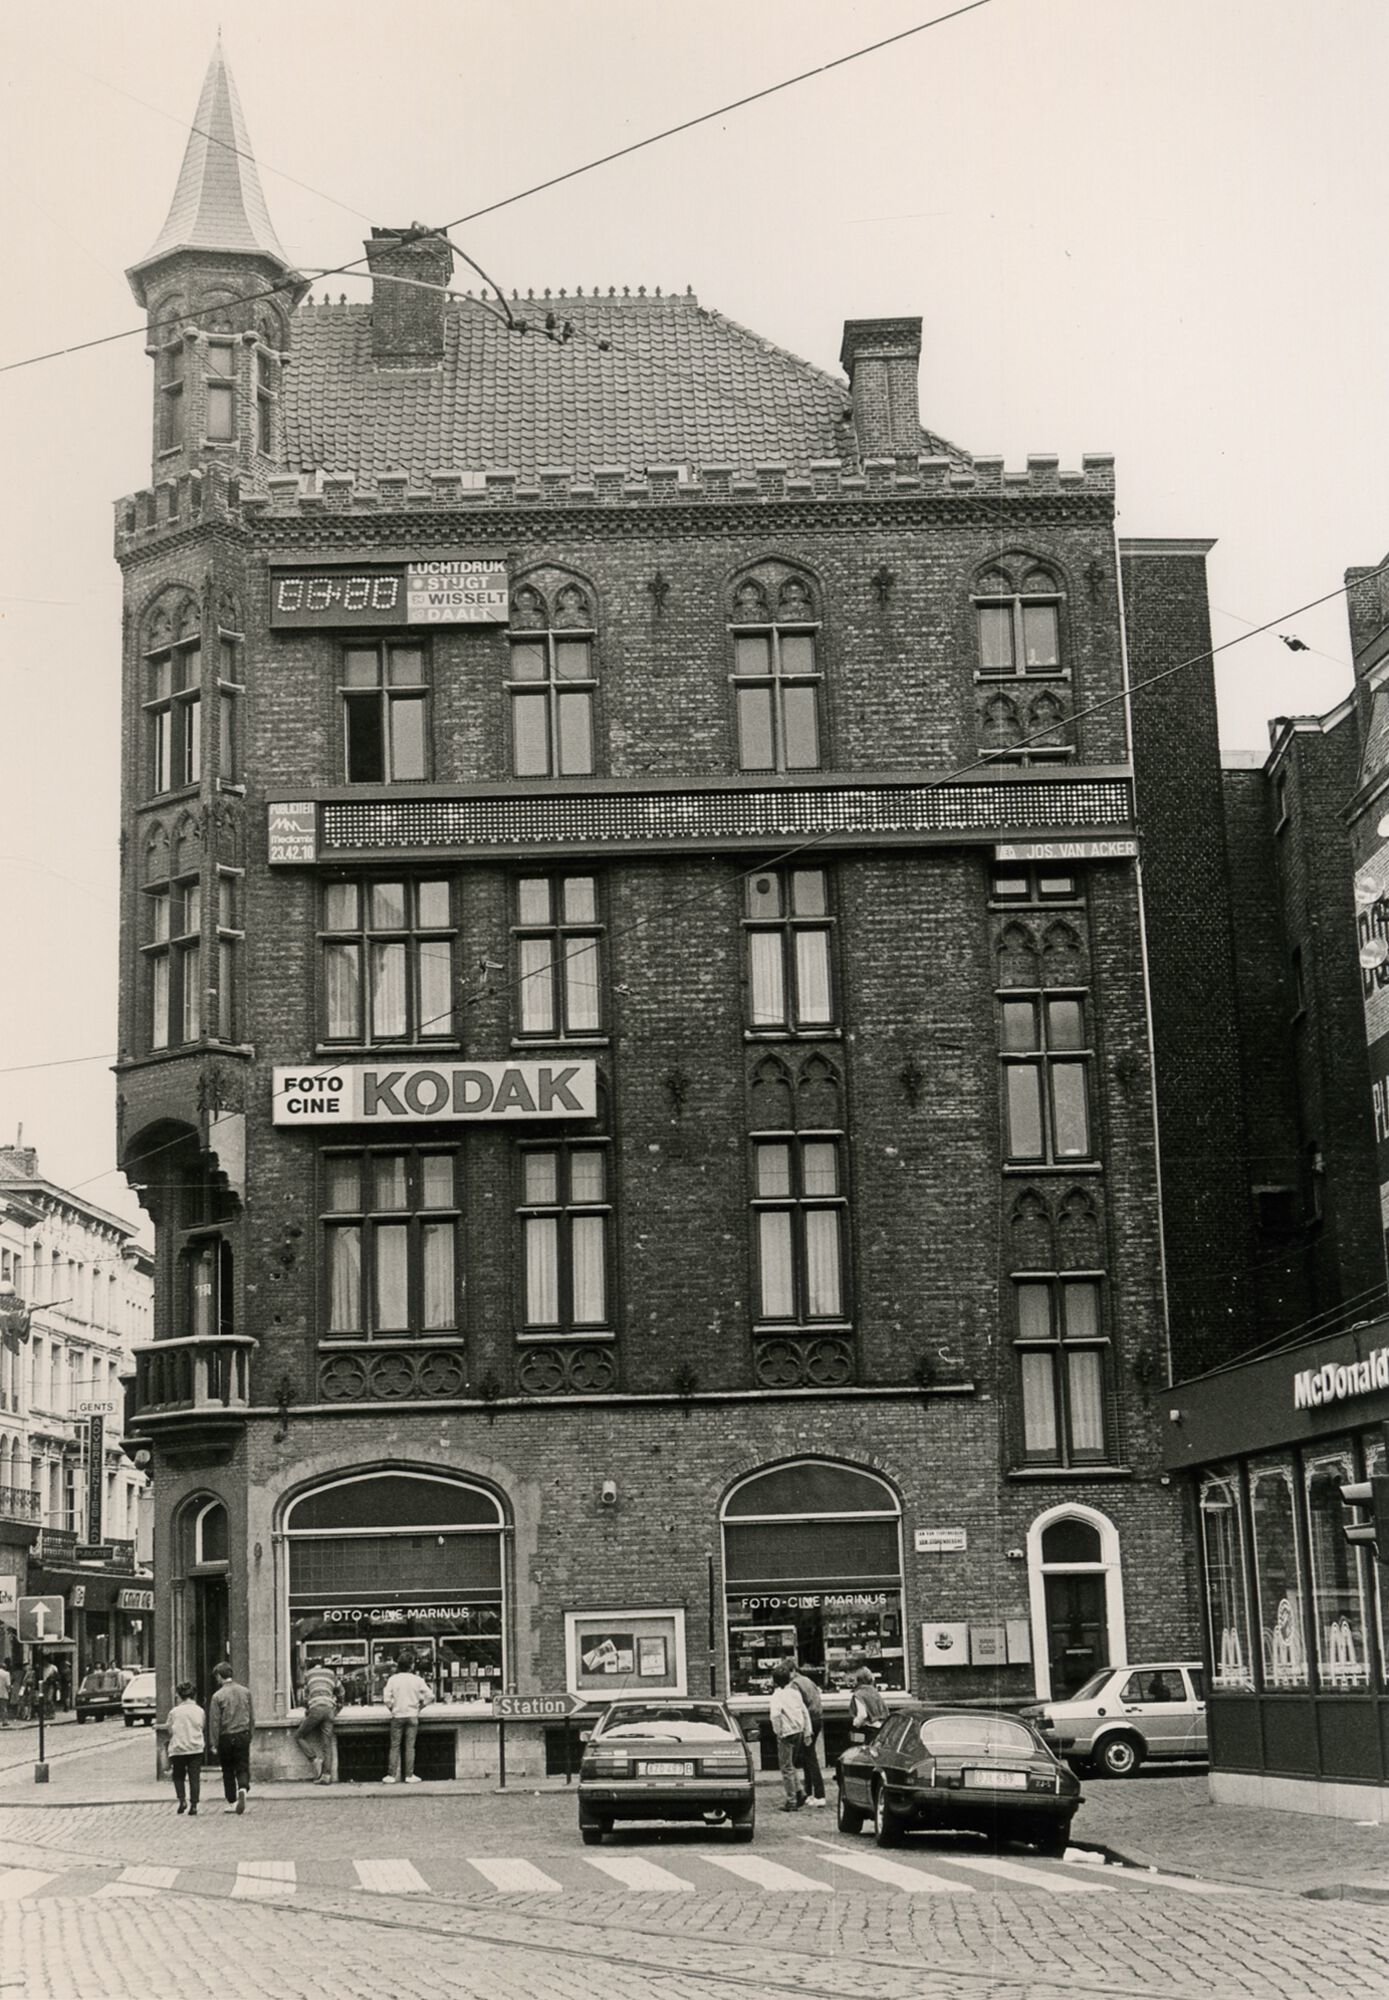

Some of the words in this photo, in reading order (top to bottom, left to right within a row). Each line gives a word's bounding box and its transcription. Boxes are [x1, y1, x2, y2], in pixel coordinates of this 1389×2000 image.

[408, 561, 506, 574] LUCHTDRUK
[428, 591, 506, 606] WISSELT
[428, 607, 490, 621] DAALT
[271, 845, 313, 860] 23.42.10
[1058, 843, 1085, 857] VAN
[1090, 841, 1136, 857] ACKER
[284, 1076, 343, 1092] FOTO
[363, 1067, 584, 1116] KODAK
[286, 1098, 340, 1114] CINE
[79, 1402, 114, 1412] GENTS
[91, 1418, 102, 1543] ADVERTENTIEBLAD
[824, 1593, 887, 1607] MARINUS
[407, 1607, 470, 1620] MARINUS
[501, 1699, 566, 1715] Station
